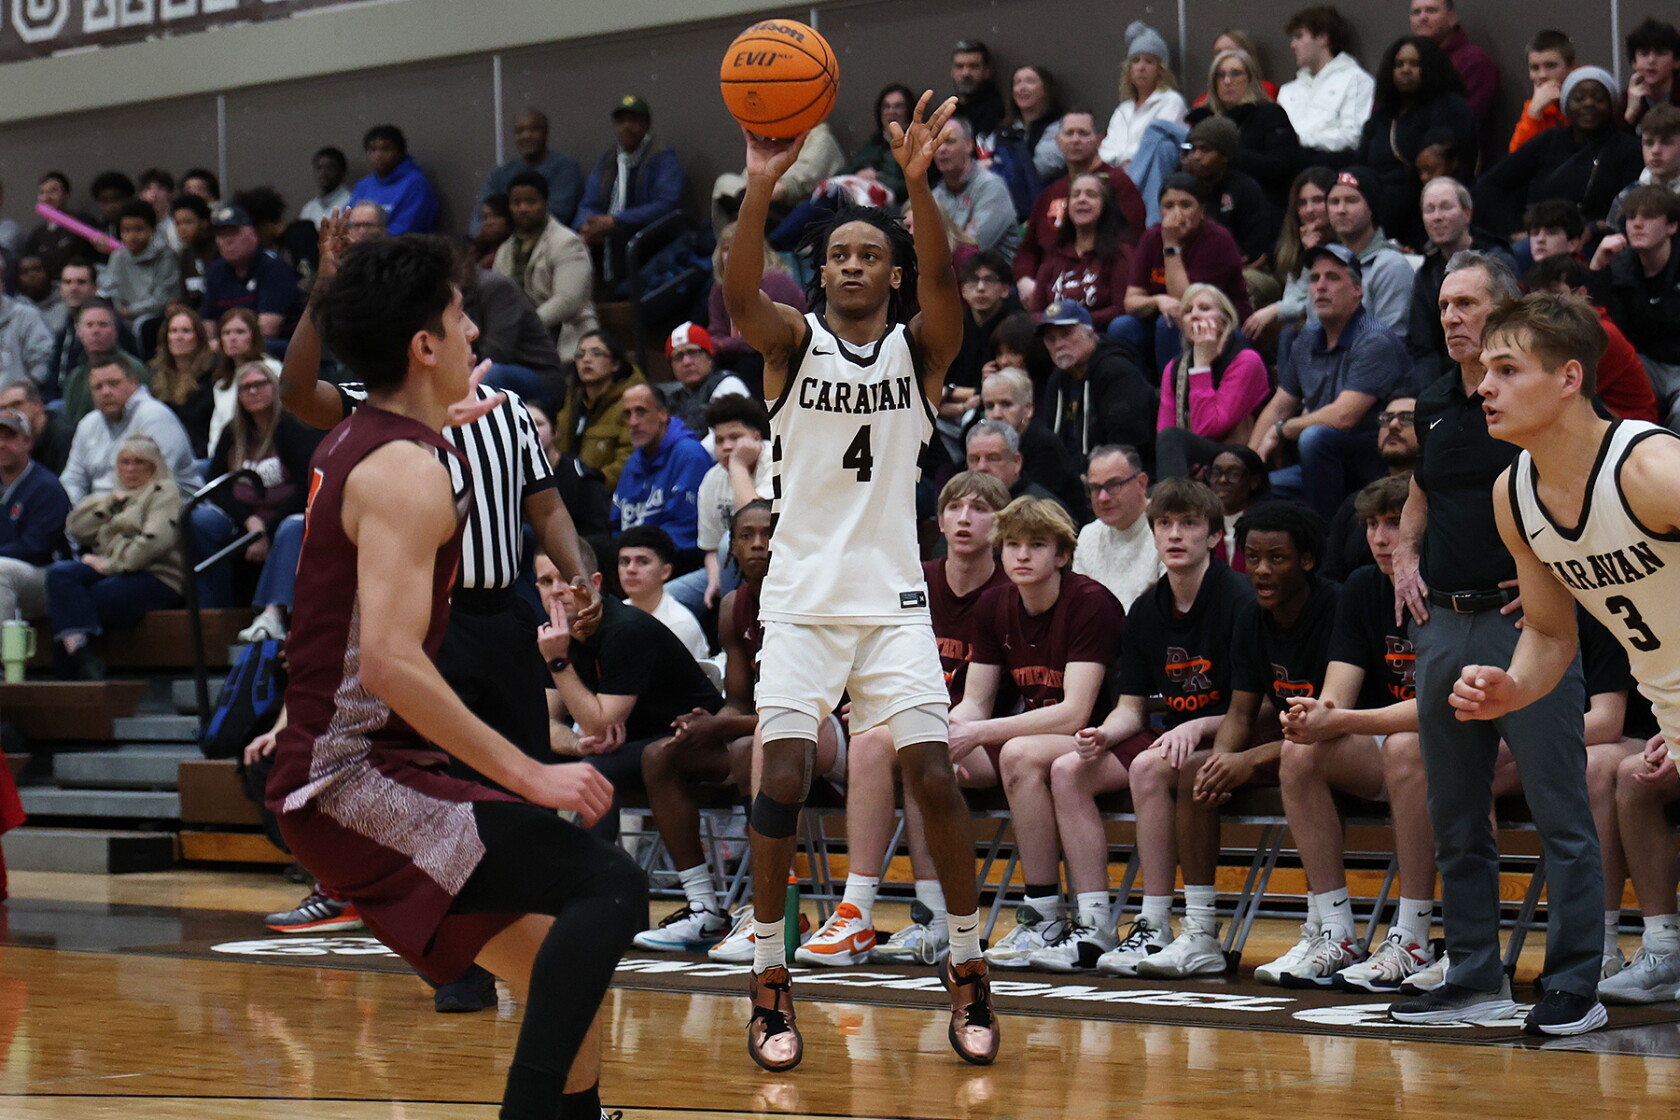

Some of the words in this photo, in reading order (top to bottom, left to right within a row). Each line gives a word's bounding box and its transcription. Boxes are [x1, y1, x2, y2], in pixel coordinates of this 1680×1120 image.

[799, 376, 911, 414] CARAVAN
[842, 424, 873, 482] 4
[1542, 540, 1666, 591] ARAVAN
[1604, 594, 1661, 653] 3
